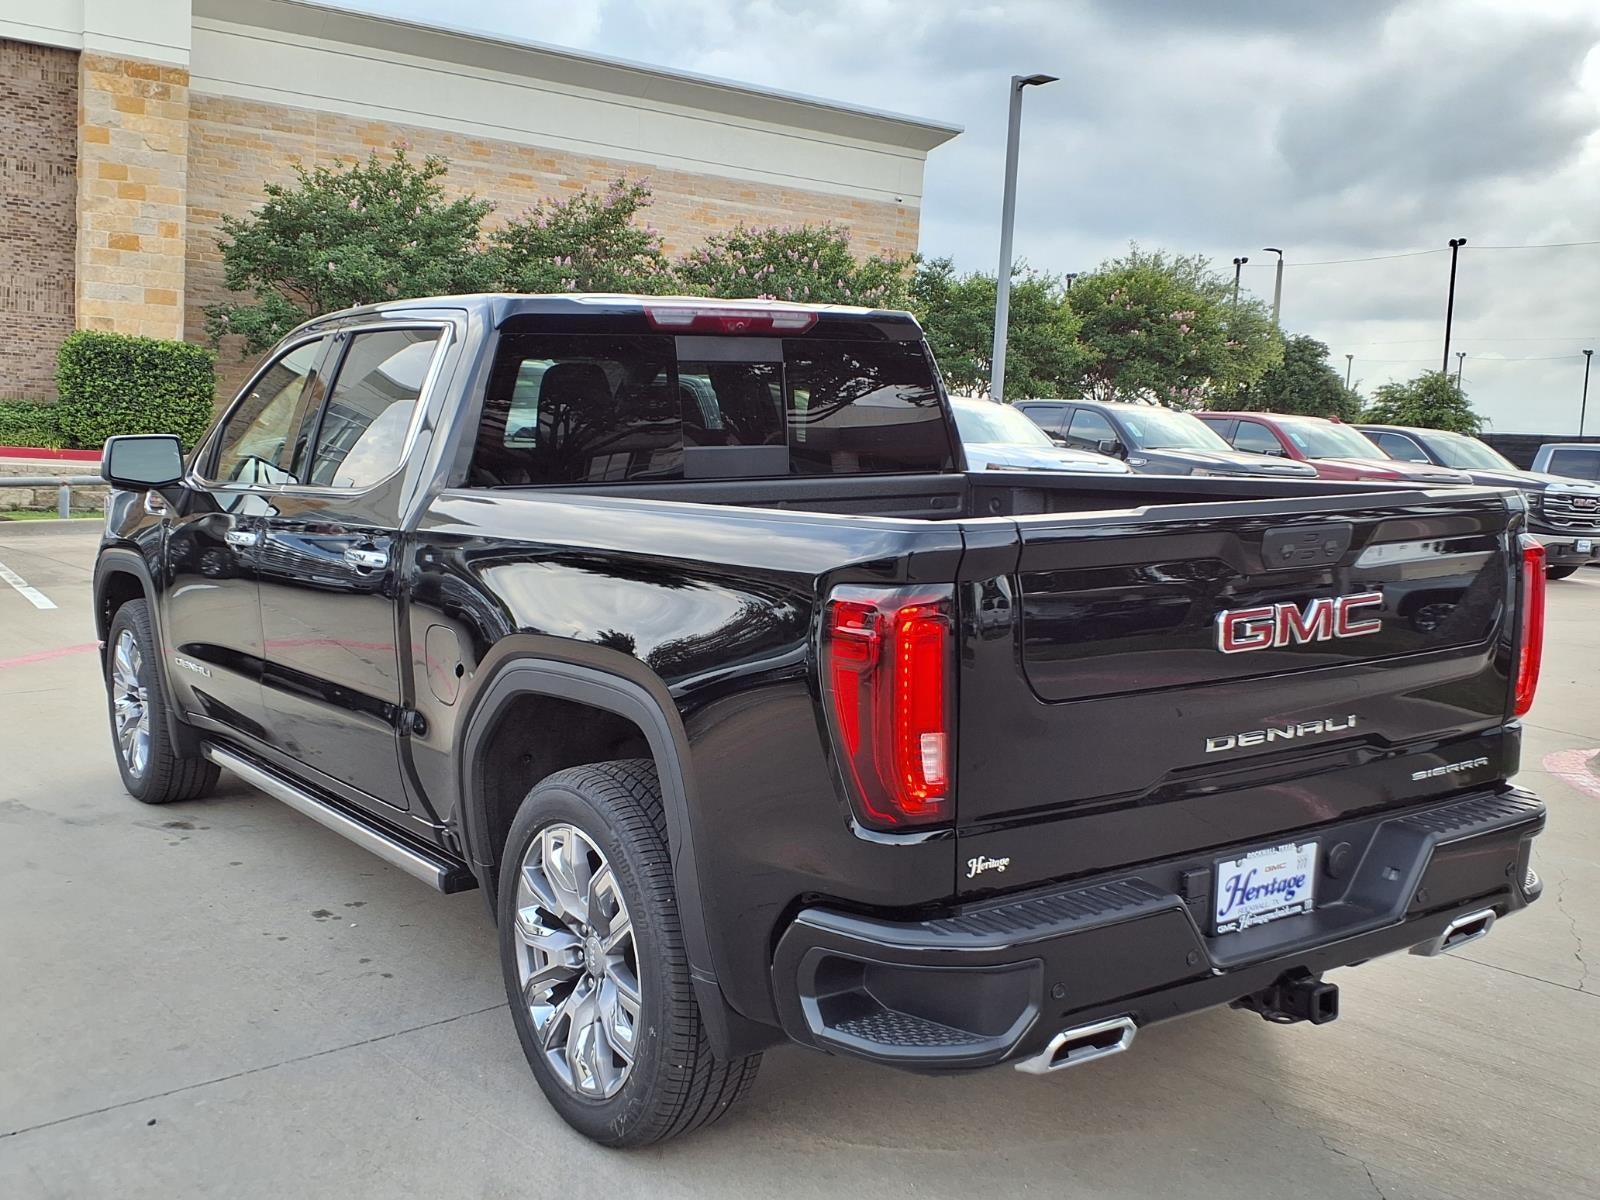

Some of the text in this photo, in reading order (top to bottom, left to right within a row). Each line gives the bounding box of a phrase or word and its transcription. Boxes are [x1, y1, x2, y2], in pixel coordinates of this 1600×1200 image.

[1217, 592, 1384, 654] GMC
[175, 657, 211, 679] DENALI
[1205, 714, 1357, 753] DENALI
[1410, 756, 1489, 781] SIERRA
[966, 855, 1010, 878] Heritage
[1265, 863, 1287, 872] GMC
[1219, 868, 1305, 916] Heritage
